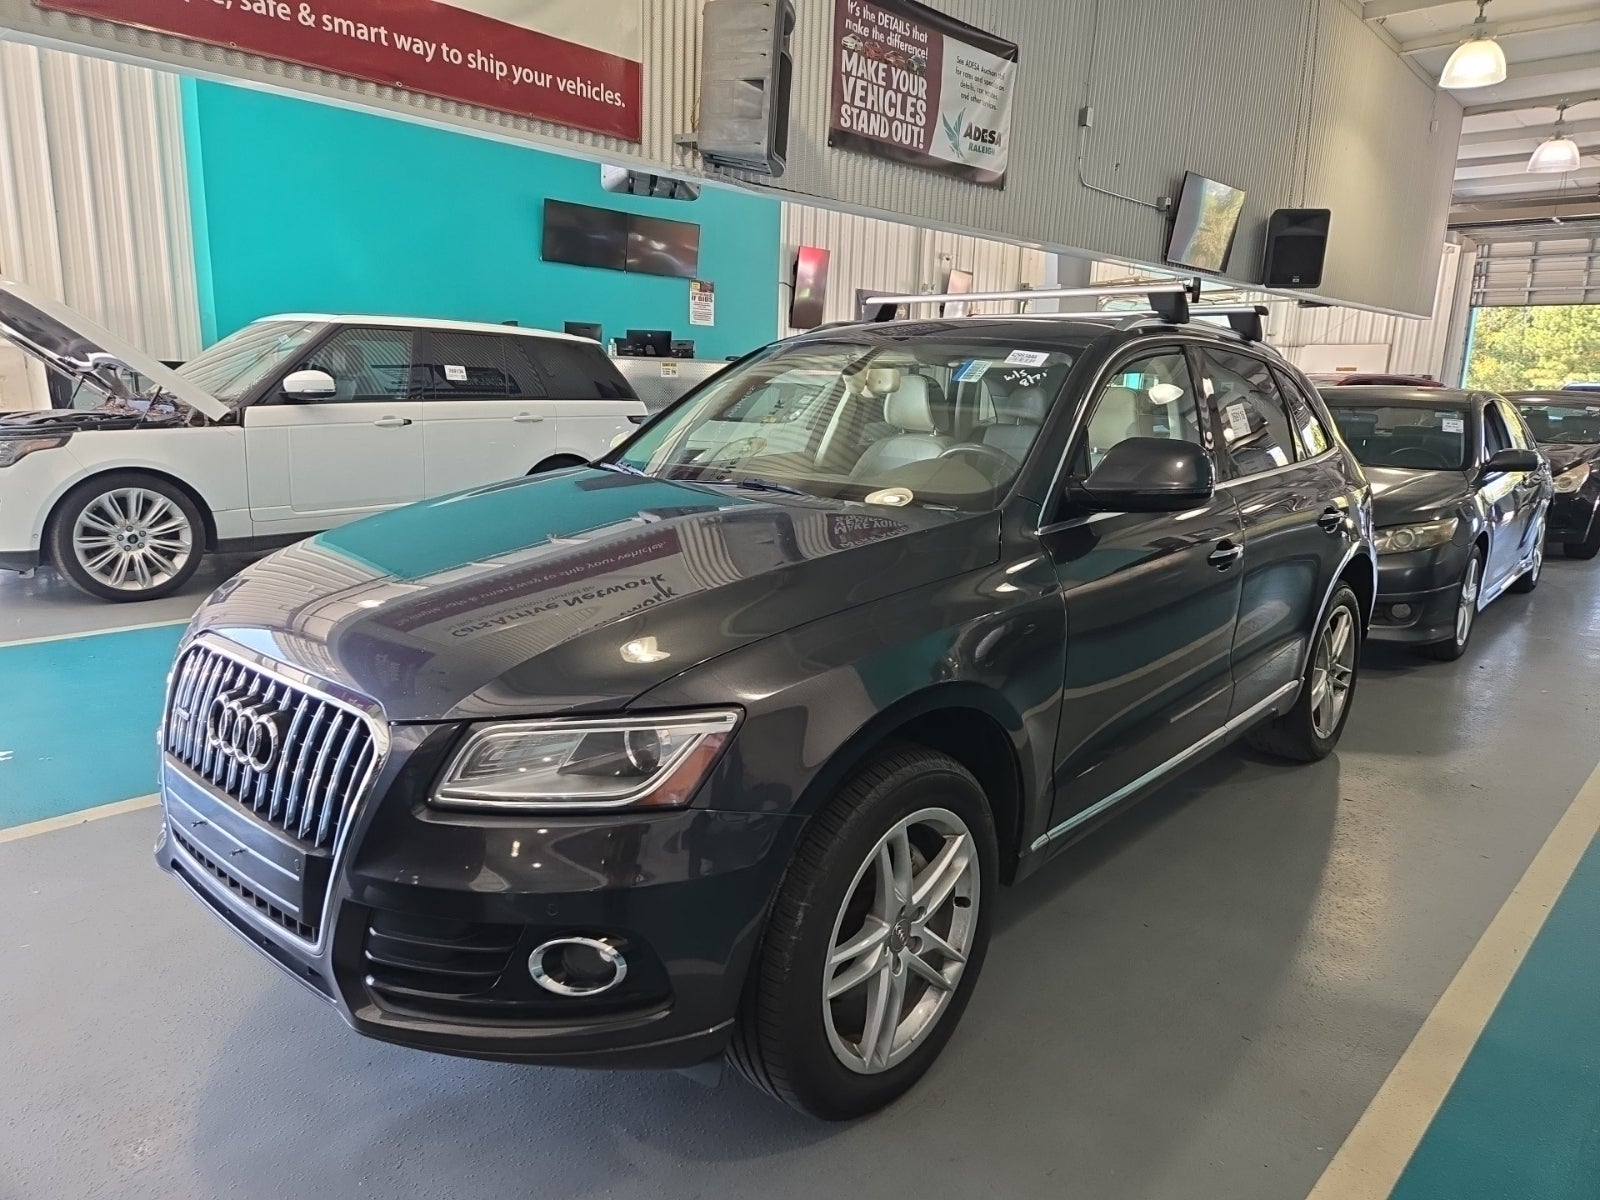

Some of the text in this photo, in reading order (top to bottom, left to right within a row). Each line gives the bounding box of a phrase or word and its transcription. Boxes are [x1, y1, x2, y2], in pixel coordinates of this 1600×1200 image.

[845, 18, 929, 60] make the difference!
[847, 0, 928, 43] It's the DETAILS that
[240, 0, 626, 108] safe & smart way to ship your vehicles.
[841, 49, 928, 100] MAKE YOUR
[841, 74, 927, 126] VEHICLES
[840, 103, 925, 149] STAND OUT!
[963, 121, 1002, 147] ADESA
